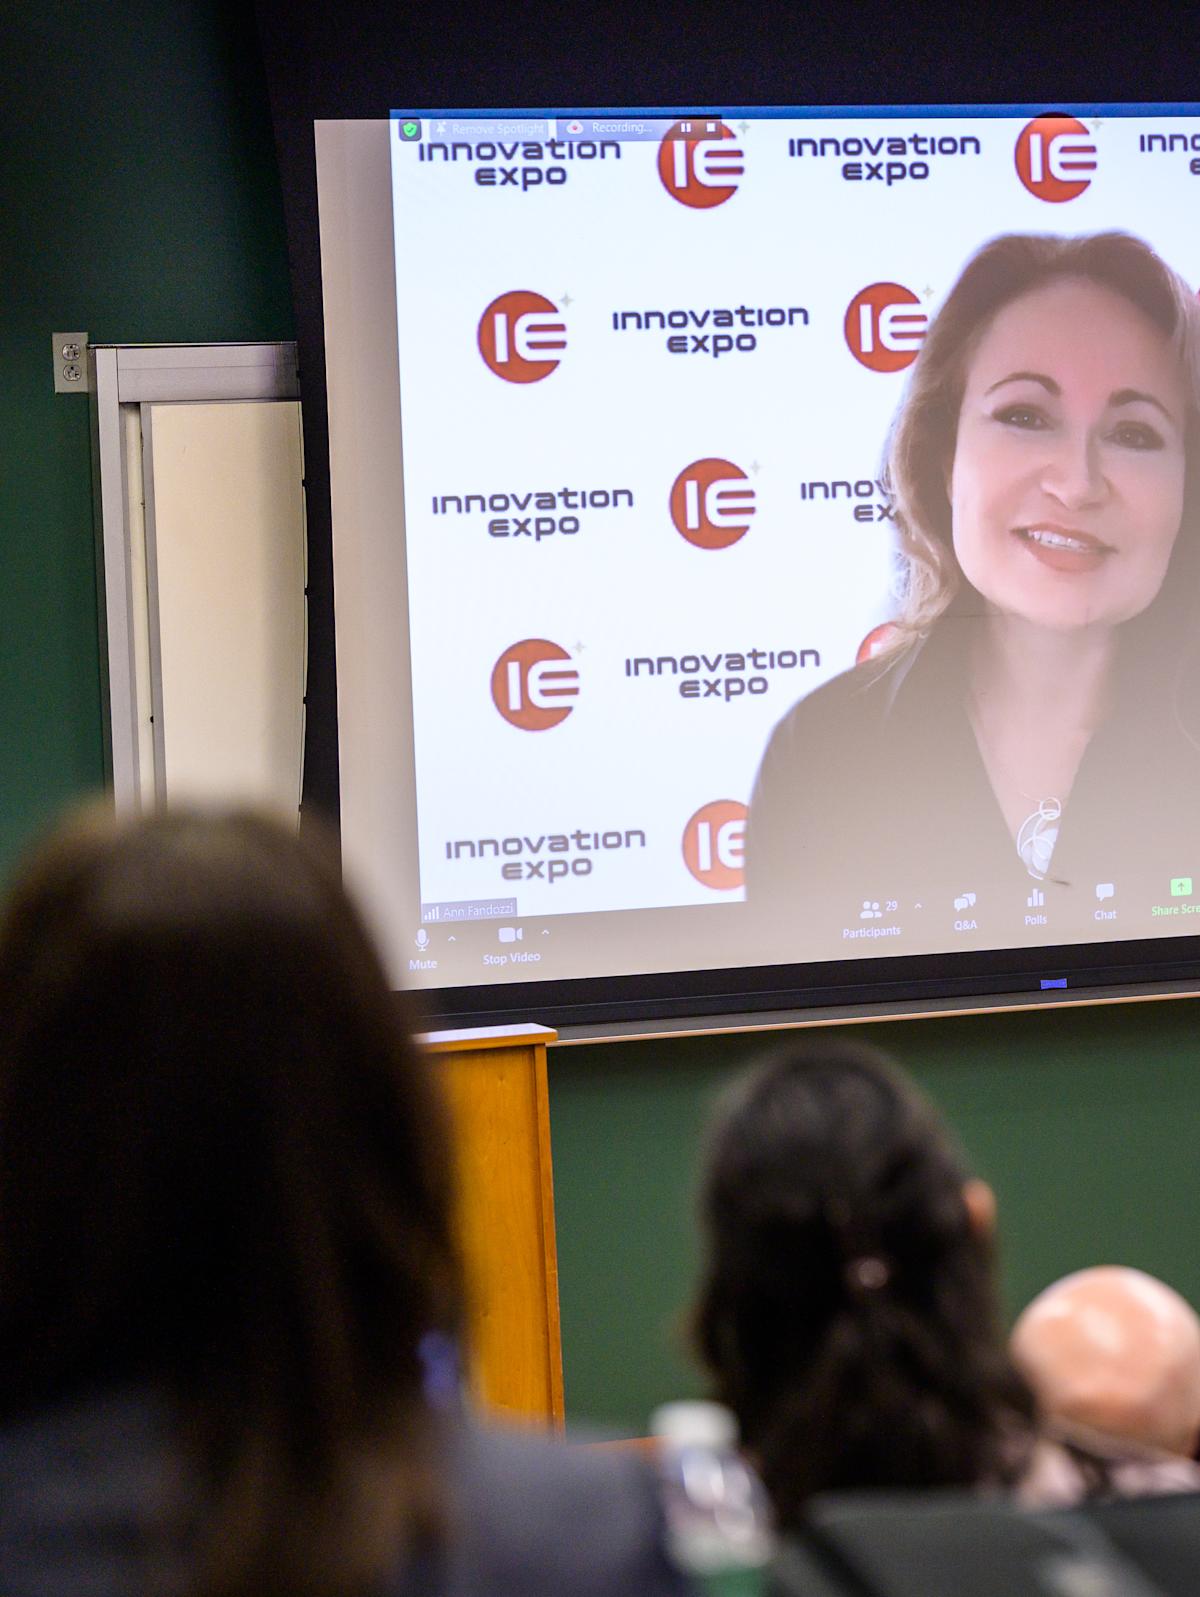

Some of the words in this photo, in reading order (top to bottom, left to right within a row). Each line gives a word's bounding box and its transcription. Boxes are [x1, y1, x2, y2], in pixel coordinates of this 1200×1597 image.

[452, 124, 494, 135] Remove
[497, 122, 544, 138] Spotlight
[789, 134, 981, 157] innovation
[475, 167, 567, 191] expo
[842, 161, 929, 185] expo
[612, 305, 809, 331] innovation
[667, 333, 756, 357] expo
[432, 488, 634, 515] innovation
[488, 518, 580, 542] expo
[625, 648, 820, 677] innovation
[679, 677, 768, 701] expo
[446, 828, 646, 860] innovation
[501, 858, 592, 883] expo
[443, 907, 465, 918] Ann
[468, 902, 514, 916] Fandozzi
[885, 900, 898, 912] 29
[1095, 909, 1117, 921] Chat
[1151, 904, 1179, 916] Share
[843, 925, 901, 939] Participants
[954, 919, 977, 931] Q&A
[1024, 915, 1047, 926] Polls
[408, 959, 438, 970] Mute
[483, 954, 507, 966] Stop
[510, 952, 541, 963] Video
